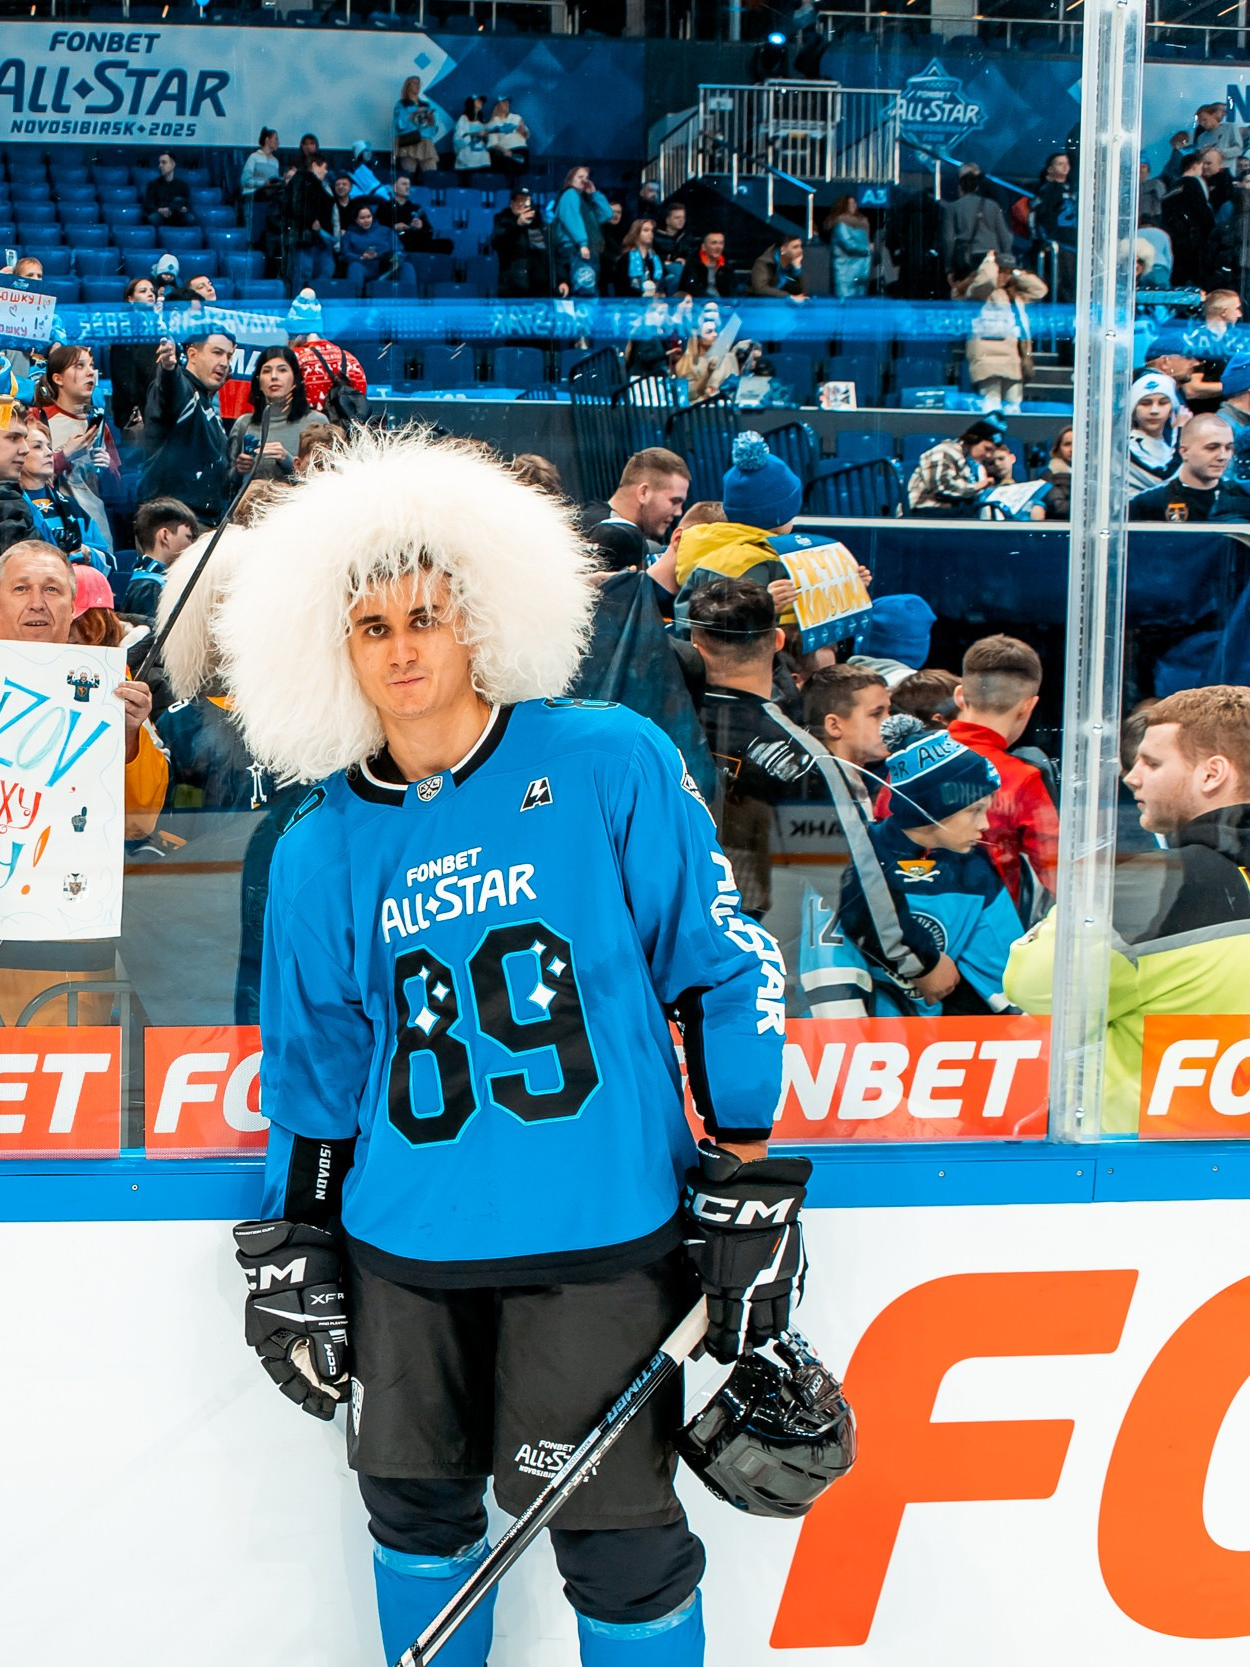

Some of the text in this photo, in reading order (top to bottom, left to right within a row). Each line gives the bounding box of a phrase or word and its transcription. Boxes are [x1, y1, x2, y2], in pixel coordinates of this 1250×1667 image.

[49, 31, 161, 53] FONBET
[10, 119, 197, 138] NOVOSIBIRSK 2025
[406, 847, 483, 888] FONBET
[387, 917, 604, 1148] 89
[323, 1343, 338, 1376] CCM
[538, 1440, 576, 1453] FONBET
